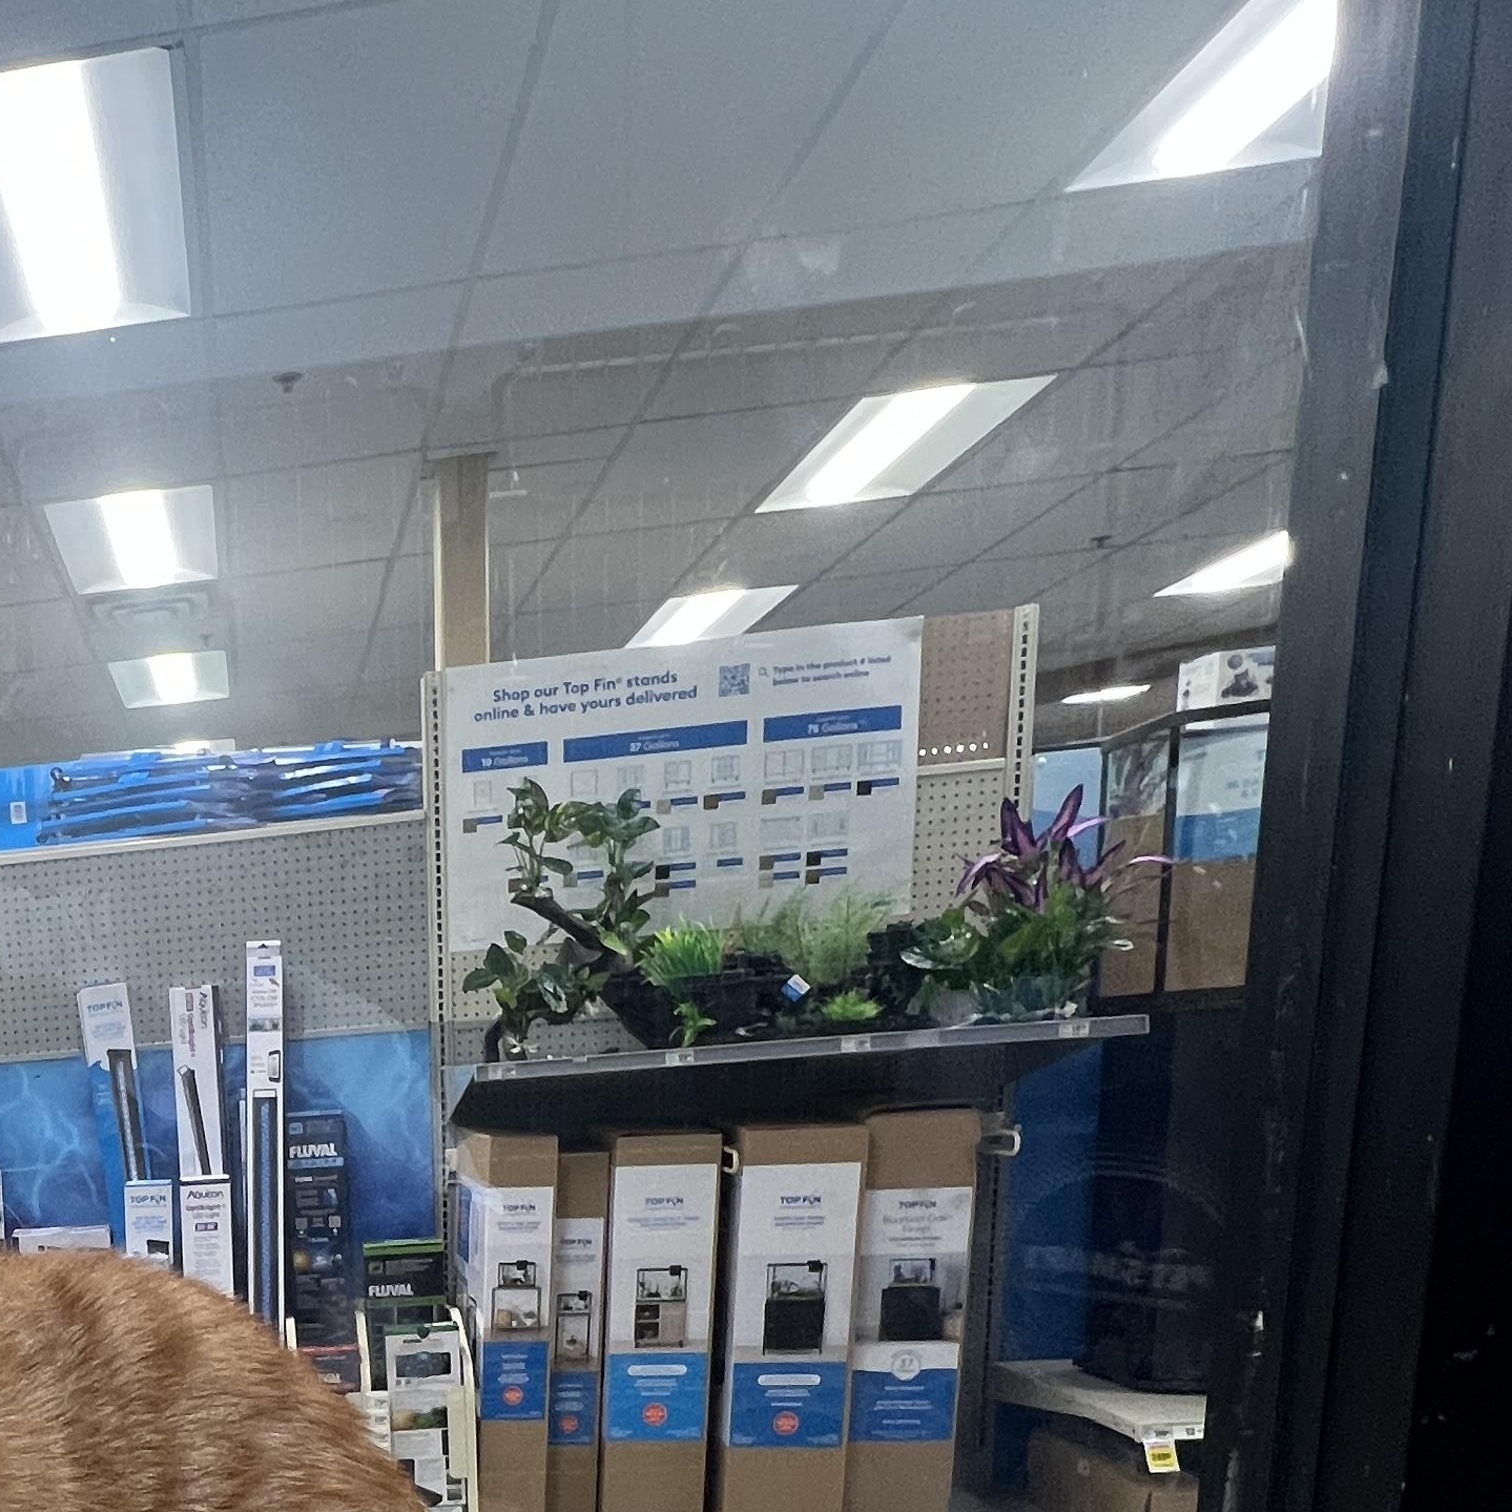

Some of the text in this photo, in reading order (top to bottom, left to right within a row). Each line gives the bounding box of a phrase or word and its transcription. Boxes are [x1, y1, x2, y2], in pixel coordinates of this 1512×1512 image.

[493, 689, 531, 703] Shop
[534, 686, 559, 698] our
[563, 682, 589, 694] Top
[626, 670, 678, 687] stands
[474, 685, 698, 722] online & have yours delivered
[87, 1004, 106, 1012] TOP
[289, 1143, 337, 1159] FLUVAL
[131, 1195, 150, 1203] TOP
[781, 1196, 802, 1204] TOP
[369, 1284, 414, 1297] FLUVAL
